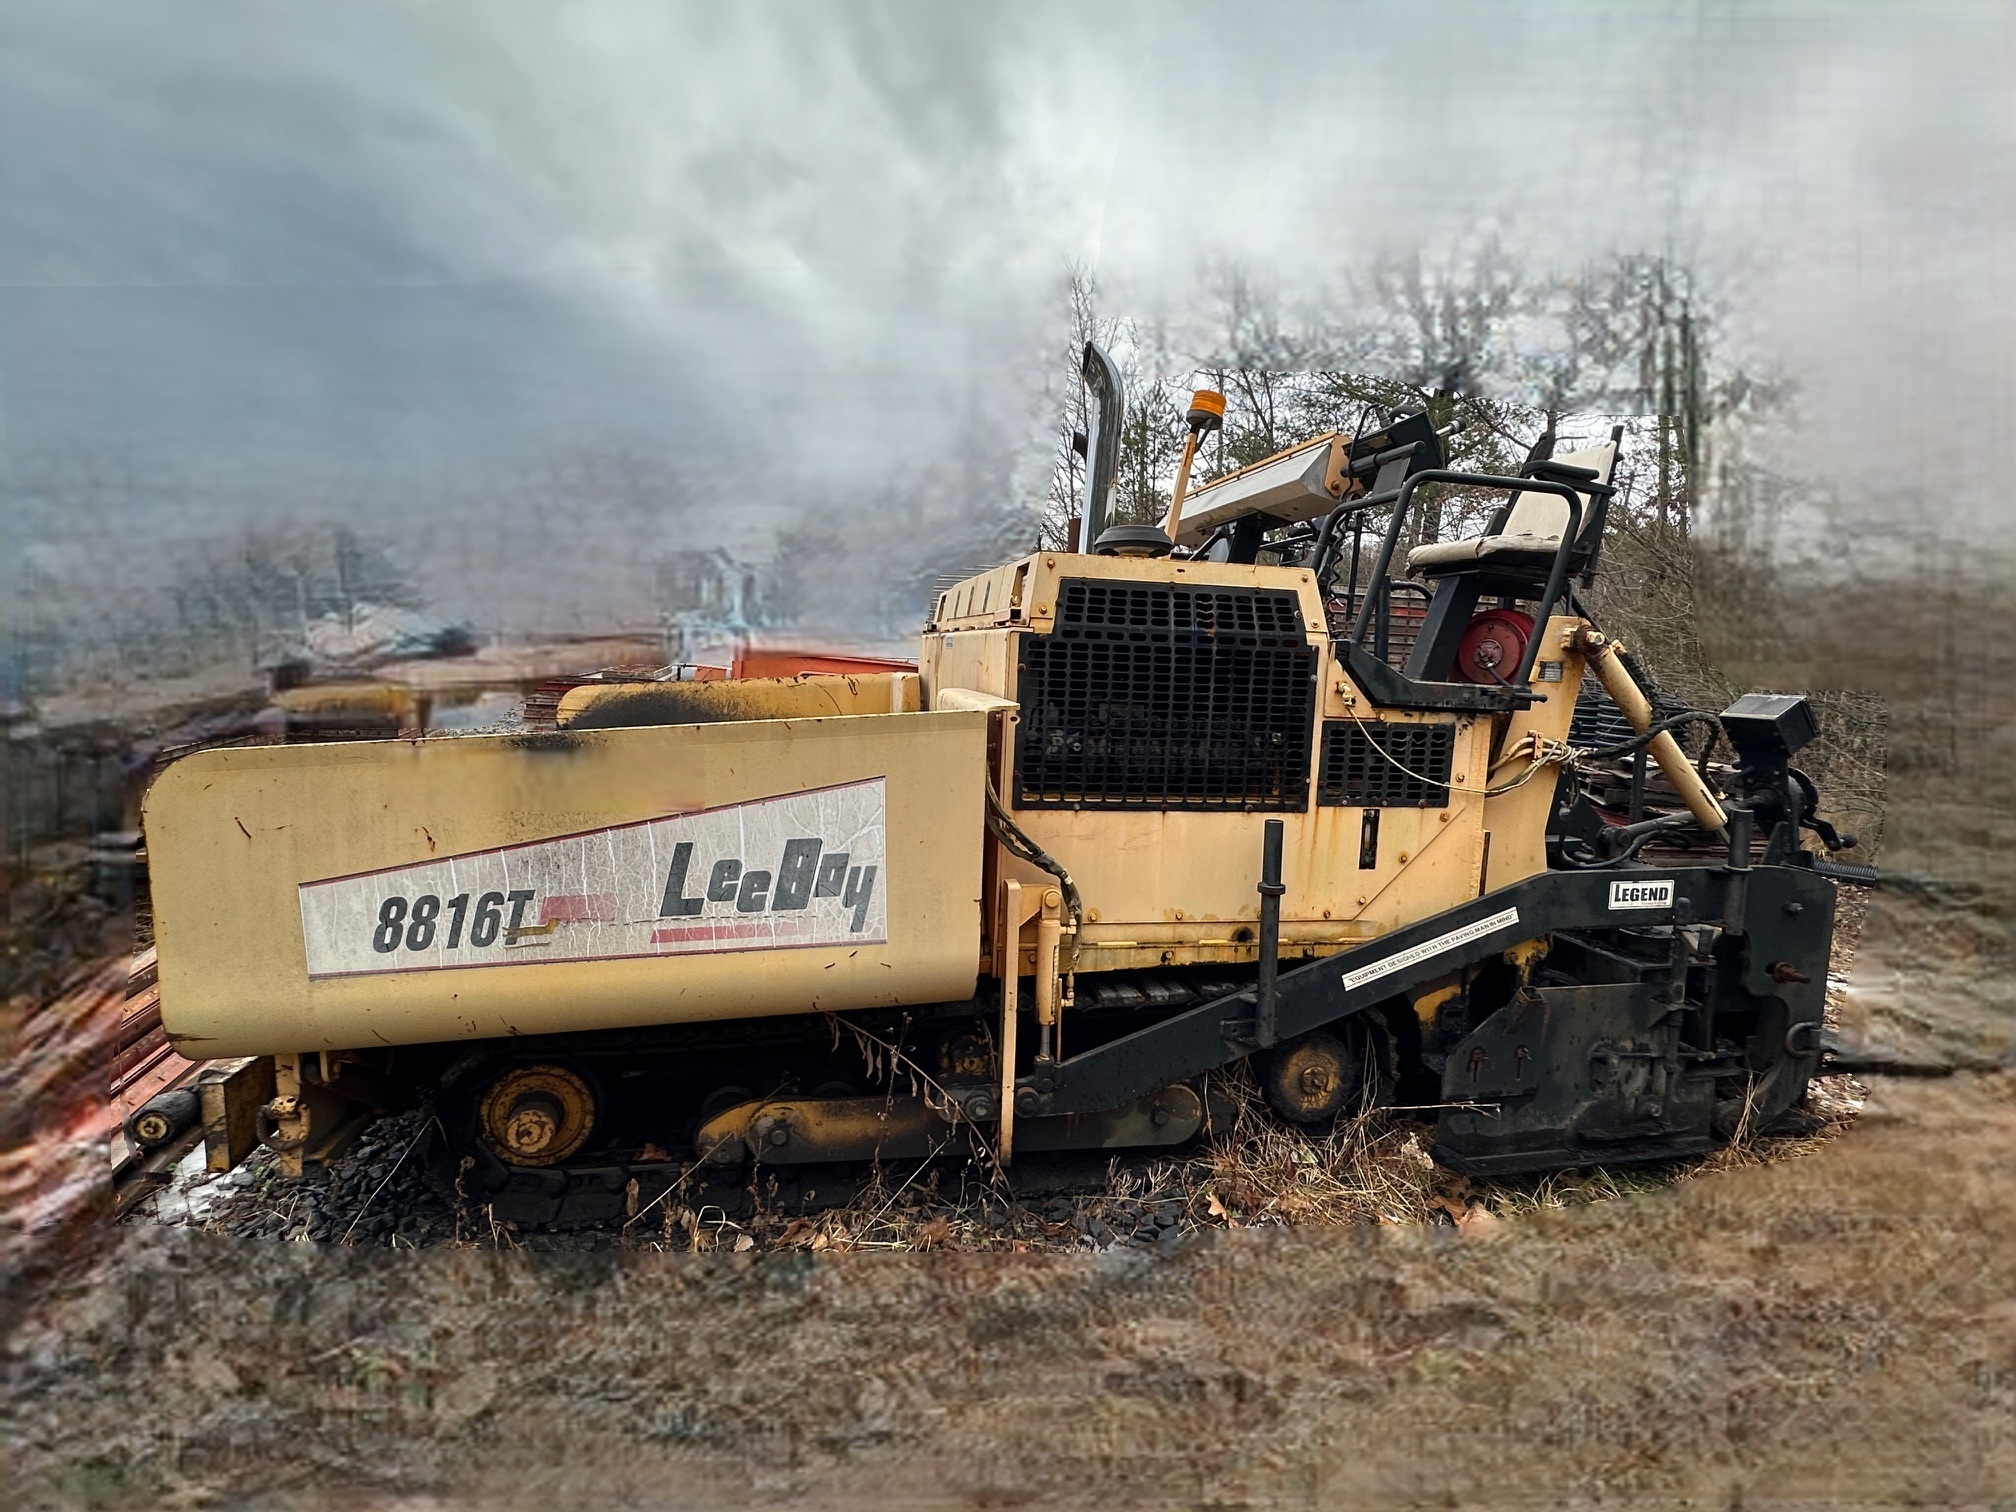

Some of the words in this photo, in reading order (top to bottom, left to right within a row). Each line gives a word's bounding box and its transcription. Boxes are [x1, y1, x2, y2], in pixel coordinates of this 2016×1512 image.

[659, 838, 878, 933] LeeBoy
[1614, 884, 1669, 902] LEGEND
[373, 889, 536, 953] 8816T
[1387, 951, 1421, 968] DESIGNED
[1421, 944, 1438, 955] WITH
[1438, 939, 1451, 948] THE
[1451, 930, 1475, 943] PAVING
[1474, 924, 1490, 934] MAN
